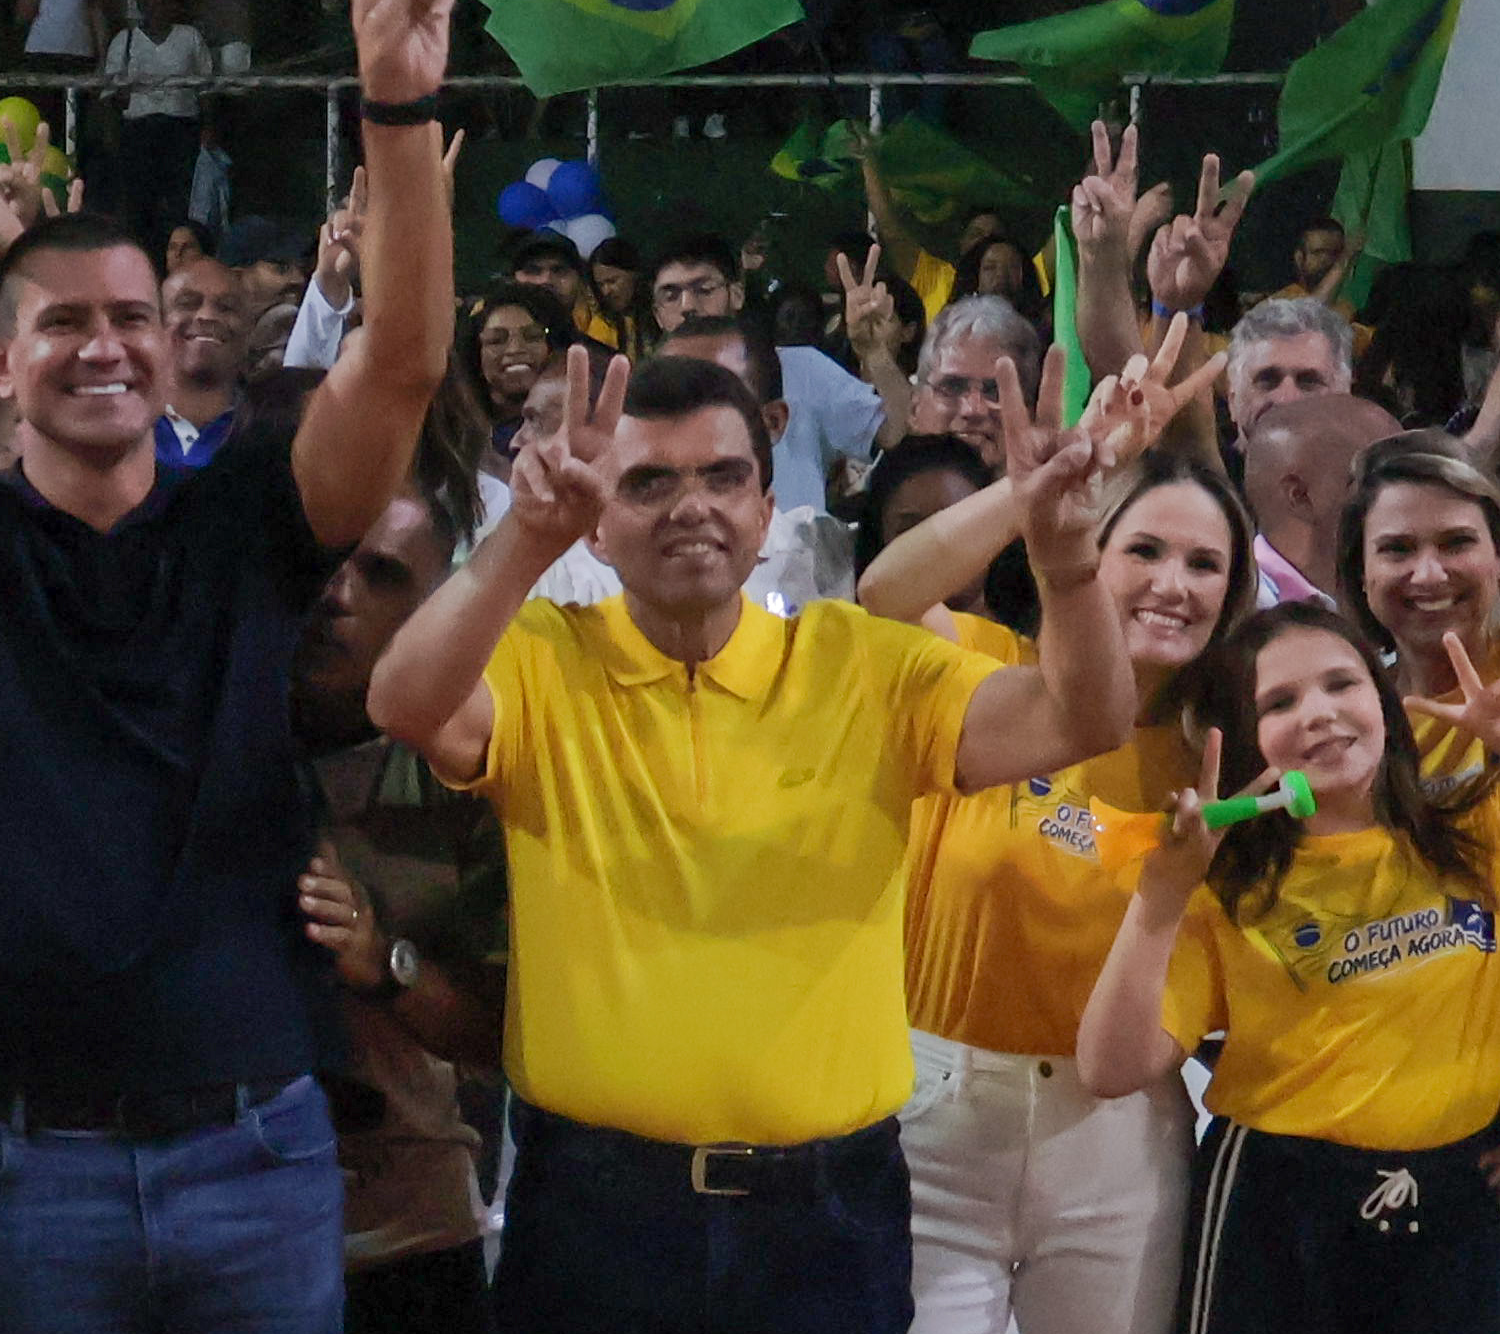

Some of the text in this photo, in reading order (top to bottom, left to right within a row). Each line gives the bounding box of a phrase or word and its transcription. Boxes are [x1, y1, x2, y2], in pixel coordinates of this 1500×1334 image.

[1058, 805, 1070, 822] O
[1344, 930, 1360, 953] O
[1367, 909, 1440, 945] FUTURO
[1327, 928, 1466, 984] COMEÇA AGORA
